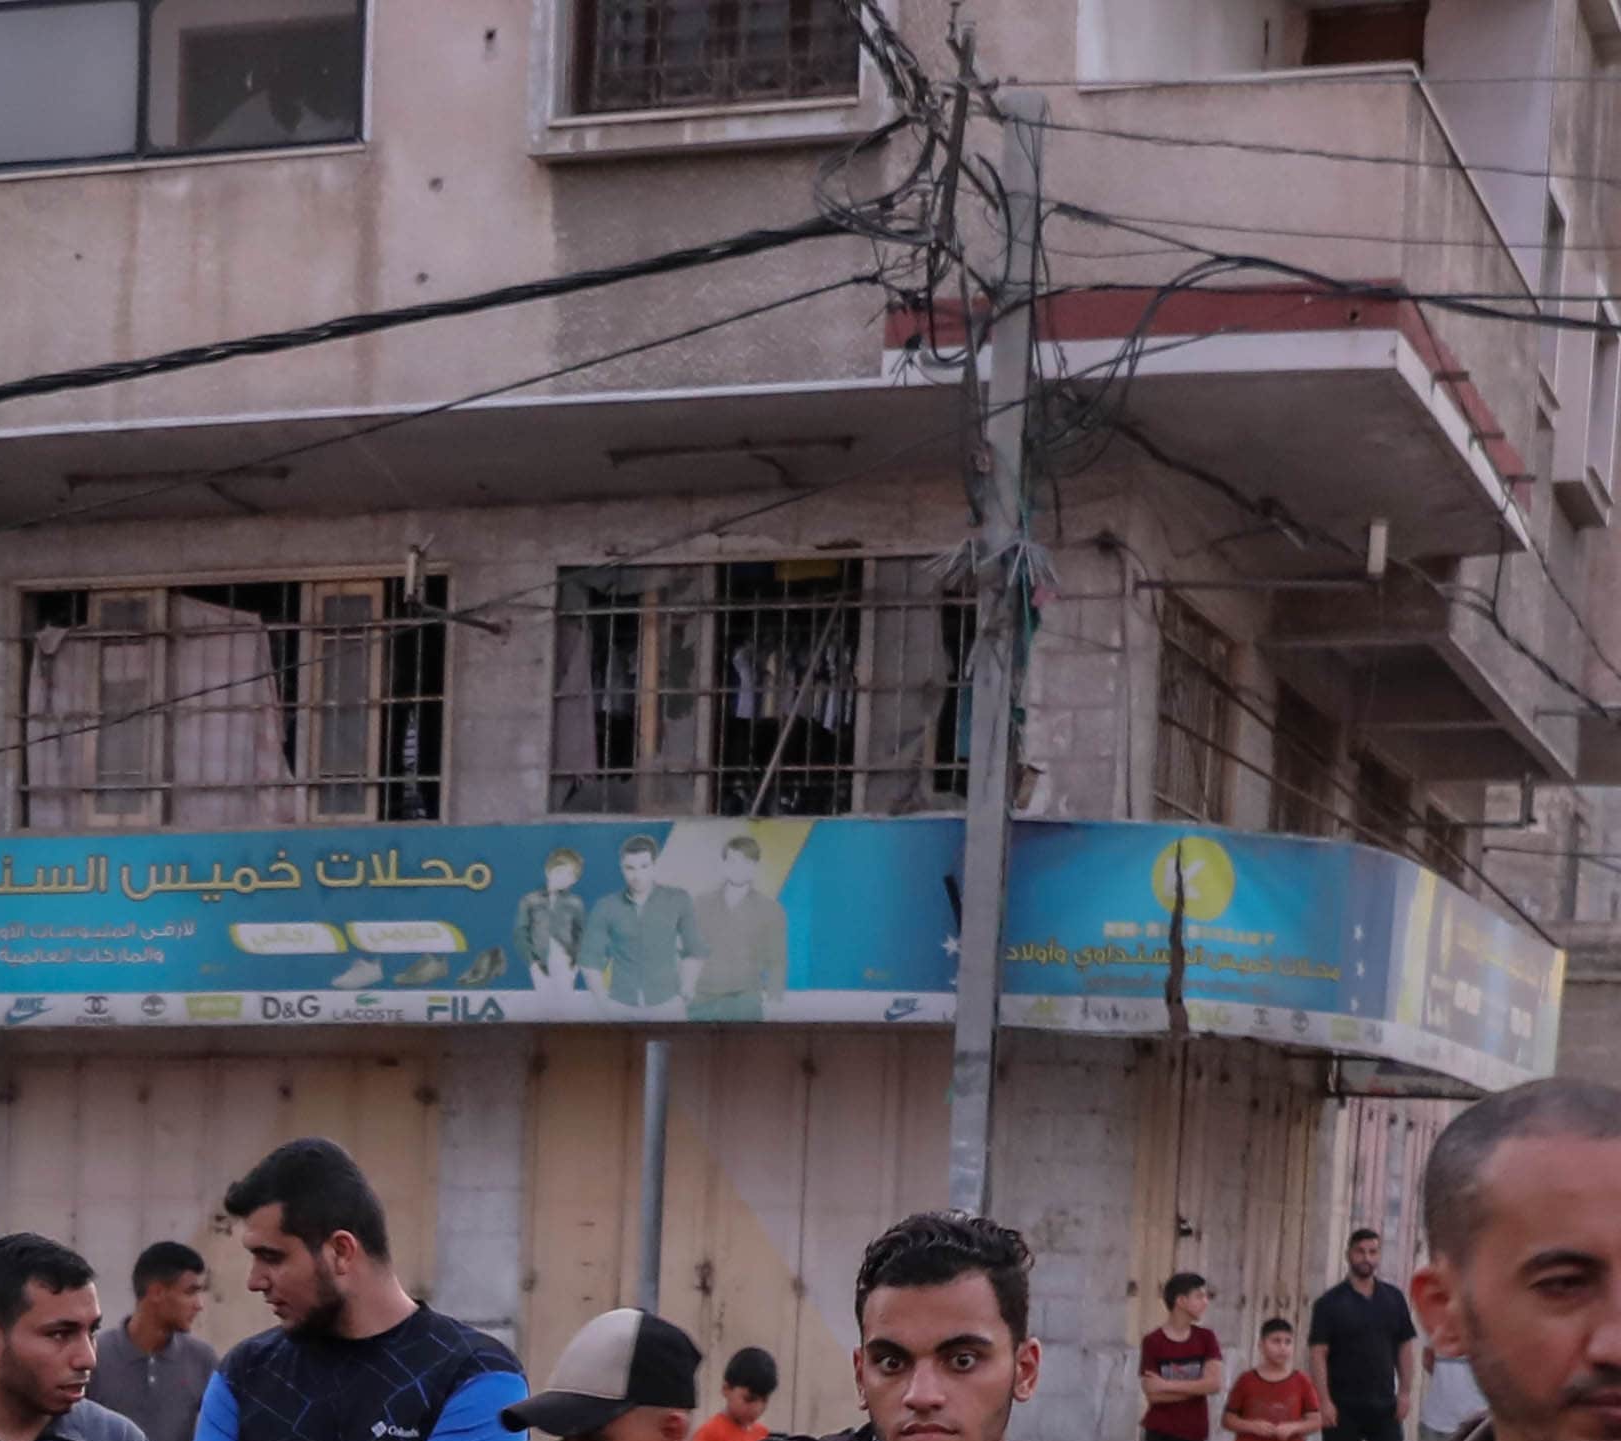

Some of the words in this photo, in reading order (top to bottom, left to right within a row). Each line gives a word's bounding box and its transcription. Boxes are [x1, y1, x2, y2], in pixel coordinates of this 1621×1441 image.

[120, 849, 304, 903] خميس
[314, 848, 494, 892] محلات
[261, 995, 322, 1021] D&G
[332, 1008, 405, 1022] LACOSTE
[425, 996, 505, 1023] FILA
